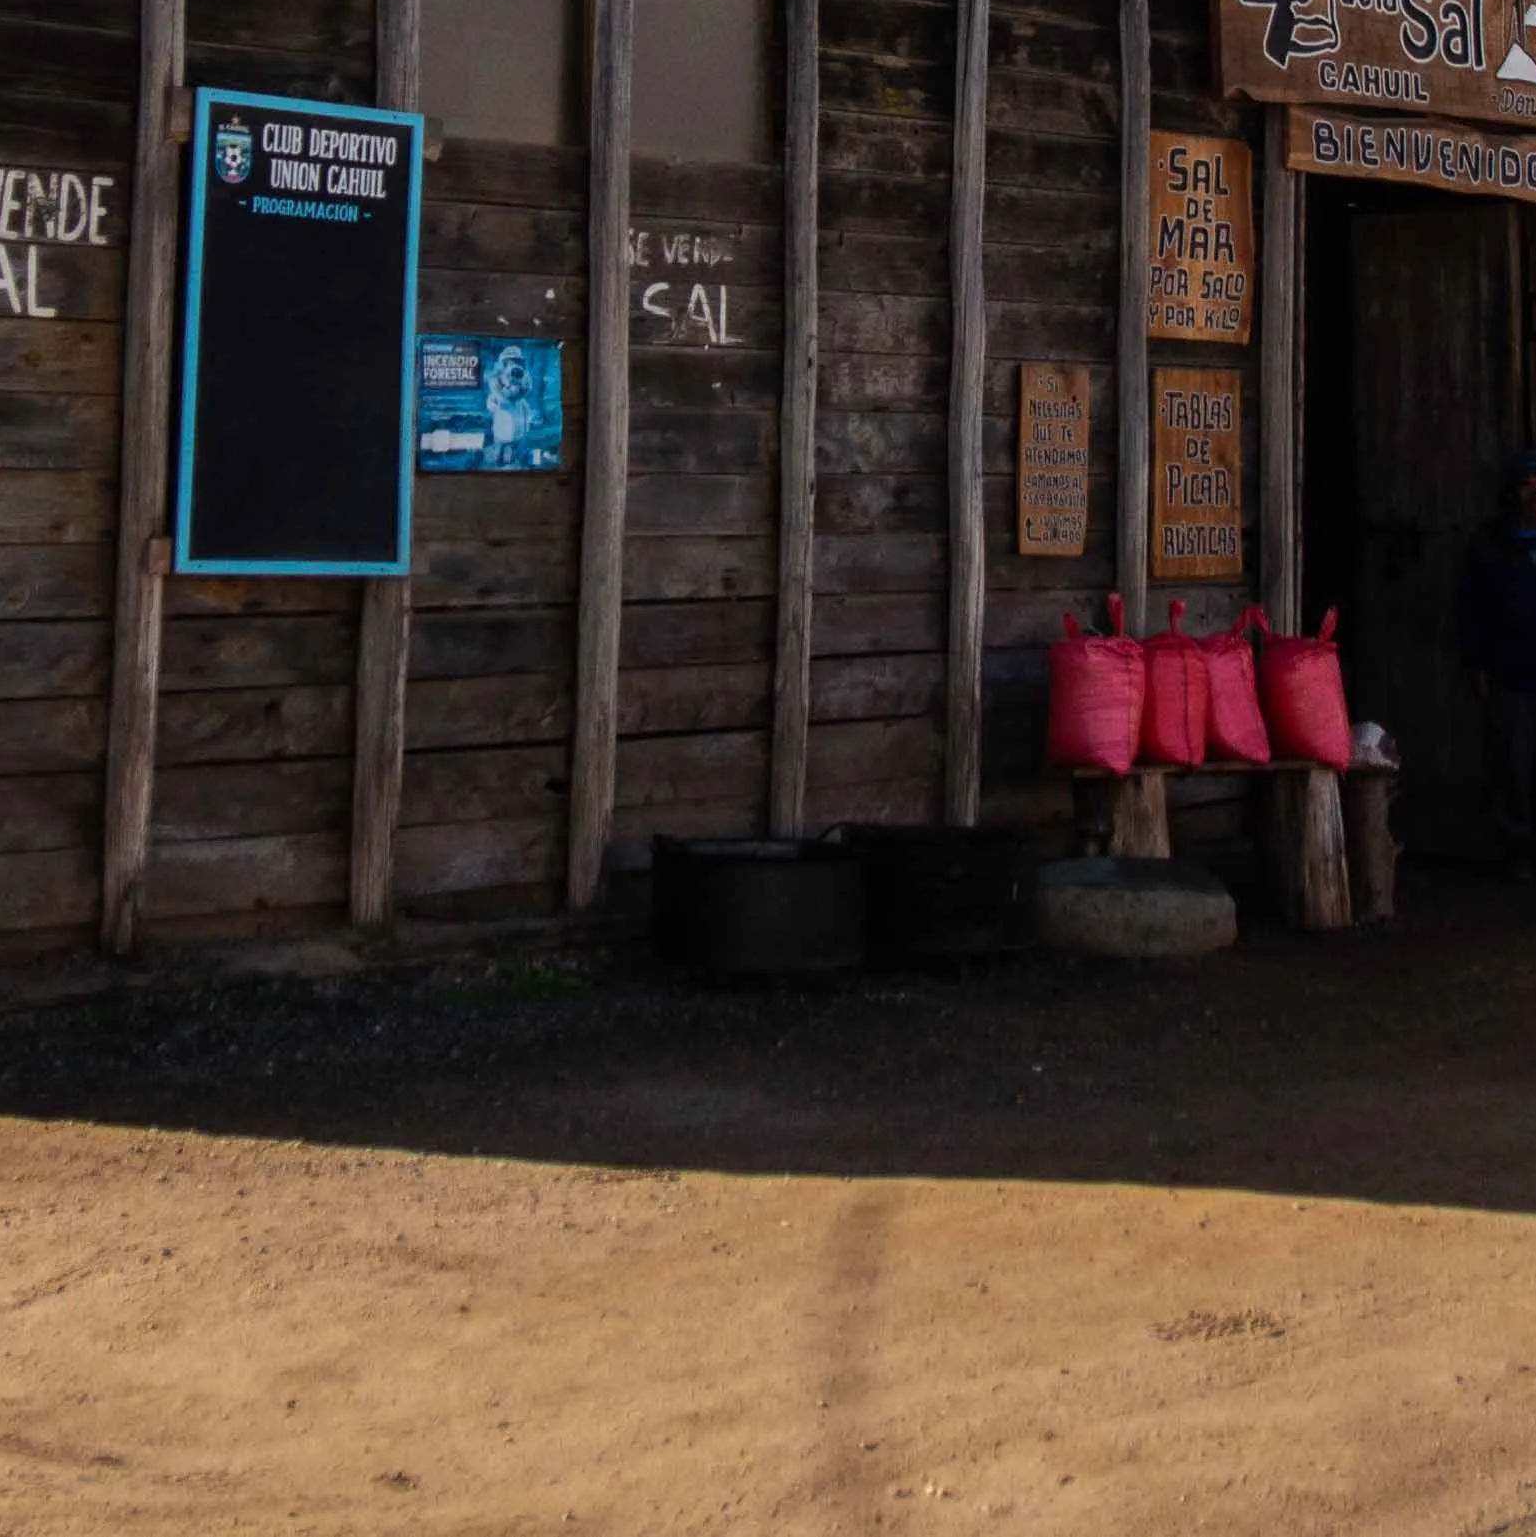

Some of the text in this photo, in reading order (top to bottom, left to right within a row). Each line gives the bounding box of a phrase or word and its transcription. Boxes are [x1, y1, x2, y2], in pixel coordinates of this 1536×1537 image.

[1318, 60, 1431, 105] CAHUIL
[263, 123, 398, 166] CLUB DEPORTIVO
[270, 158, 386, 199] UNION CAHUIL
[1167, 146, 1230, 196] SAL
[252, 195, 359, 223] PROGRAMACIÓN
[1186, 197, 1213, 224] DE
[1158, 215, 1235, 264] MAR
[1150, 266, 1246, 302] POR SACO
[1148, 303, 1161, 325] Y
[1164, 304, 1195, 329] POR
[423, 354, 479, 368] INCENDIO
[423, 367, 476, 381] FORESTAL
[1029, 399, 1083, 419] NECESITAS
[1165, 391, 1233, 430] TABLAS
[1024, 447, 1089, 465] ATENDAMOS
[1186, 438, 1211, 465] DE
[1166, 464, 1231, 505] PICAR
